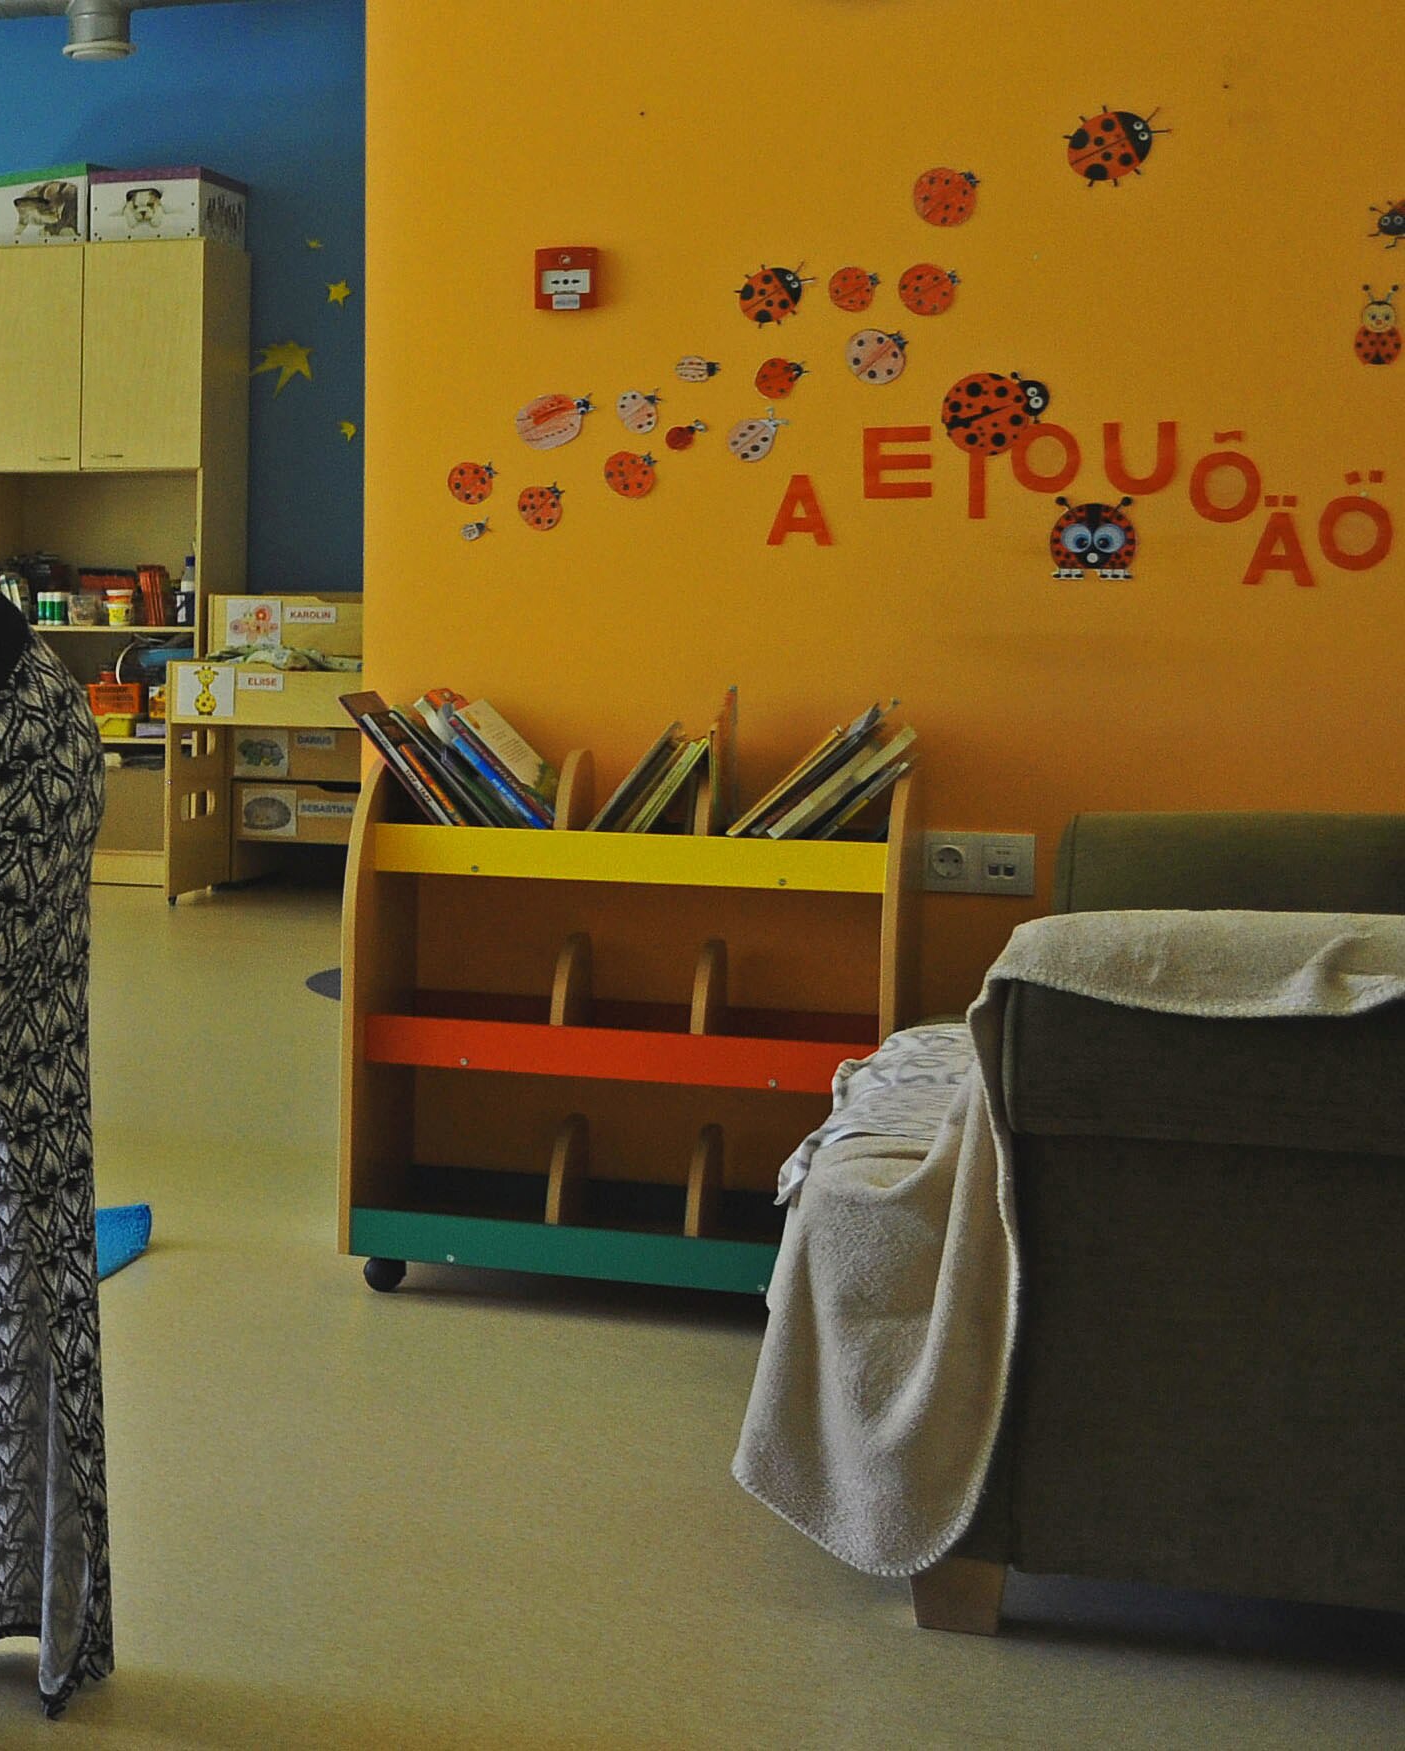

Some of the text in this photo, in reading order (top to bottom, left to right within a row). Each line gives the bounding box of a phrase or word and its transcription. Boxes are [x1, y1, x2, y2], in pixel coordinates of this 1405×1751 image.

[766, 475, 832, 546] A
[862, 425, 932, 499] E
[1011, 423, 1081, 493] O
[1103, 421, 1177, 495] U
[1190, 430, 1262, 523] Õ
[1242, 495, 1316, 587] Ä
[1318, 470, 1393, 571] Ö
[289, 610, 331, 620] KAROLIN
[247, 677, 277, 687] ELIISE
[297, 735, 333, 746] DARIUS
